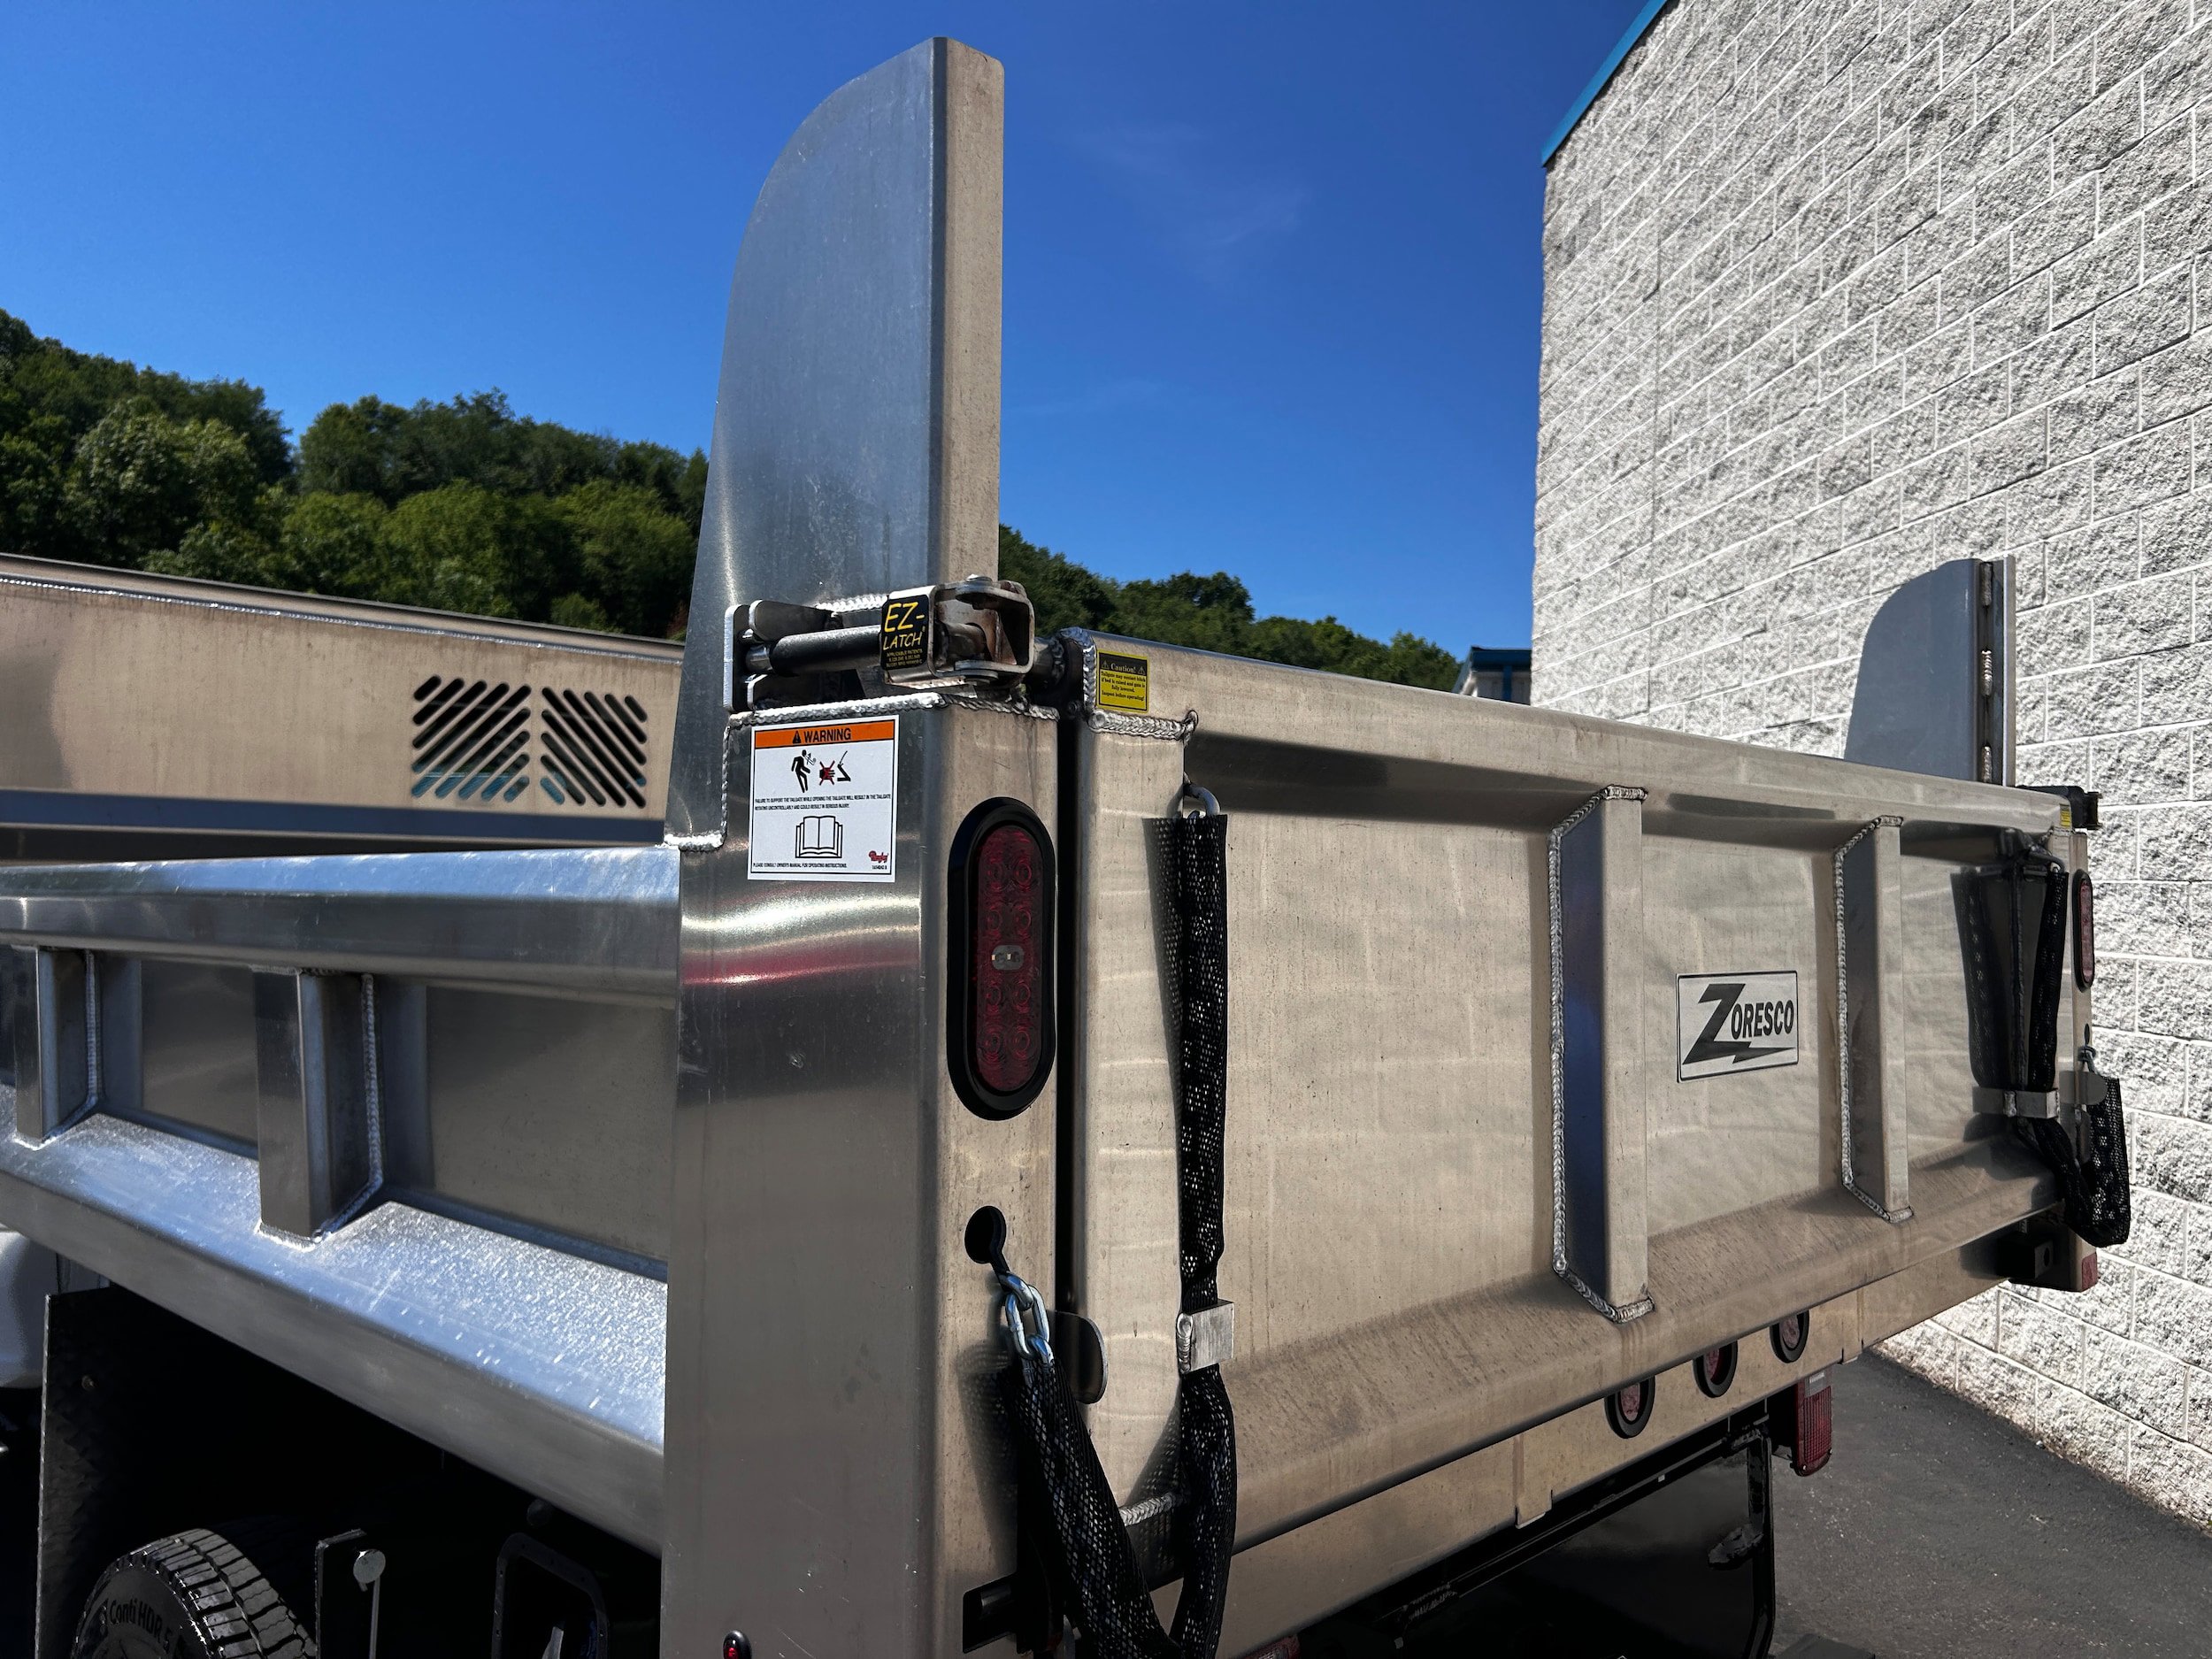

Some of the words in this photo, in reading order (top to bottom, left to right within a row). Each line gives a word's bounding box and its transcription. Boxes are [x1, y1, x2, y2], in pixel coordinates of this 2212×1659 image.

[884, 602, 925, 633] EZ-
[883, 631, 923, 650] LATCH
[1110, 663, 1137, 672] Caution!
[803, 727, 851, 743] WARNING
[1682, 983, 1796, 1065] ZORESCO
[110, 1598, 137, 1624] Conti
[138, 1601, 162, 1643] HDR
